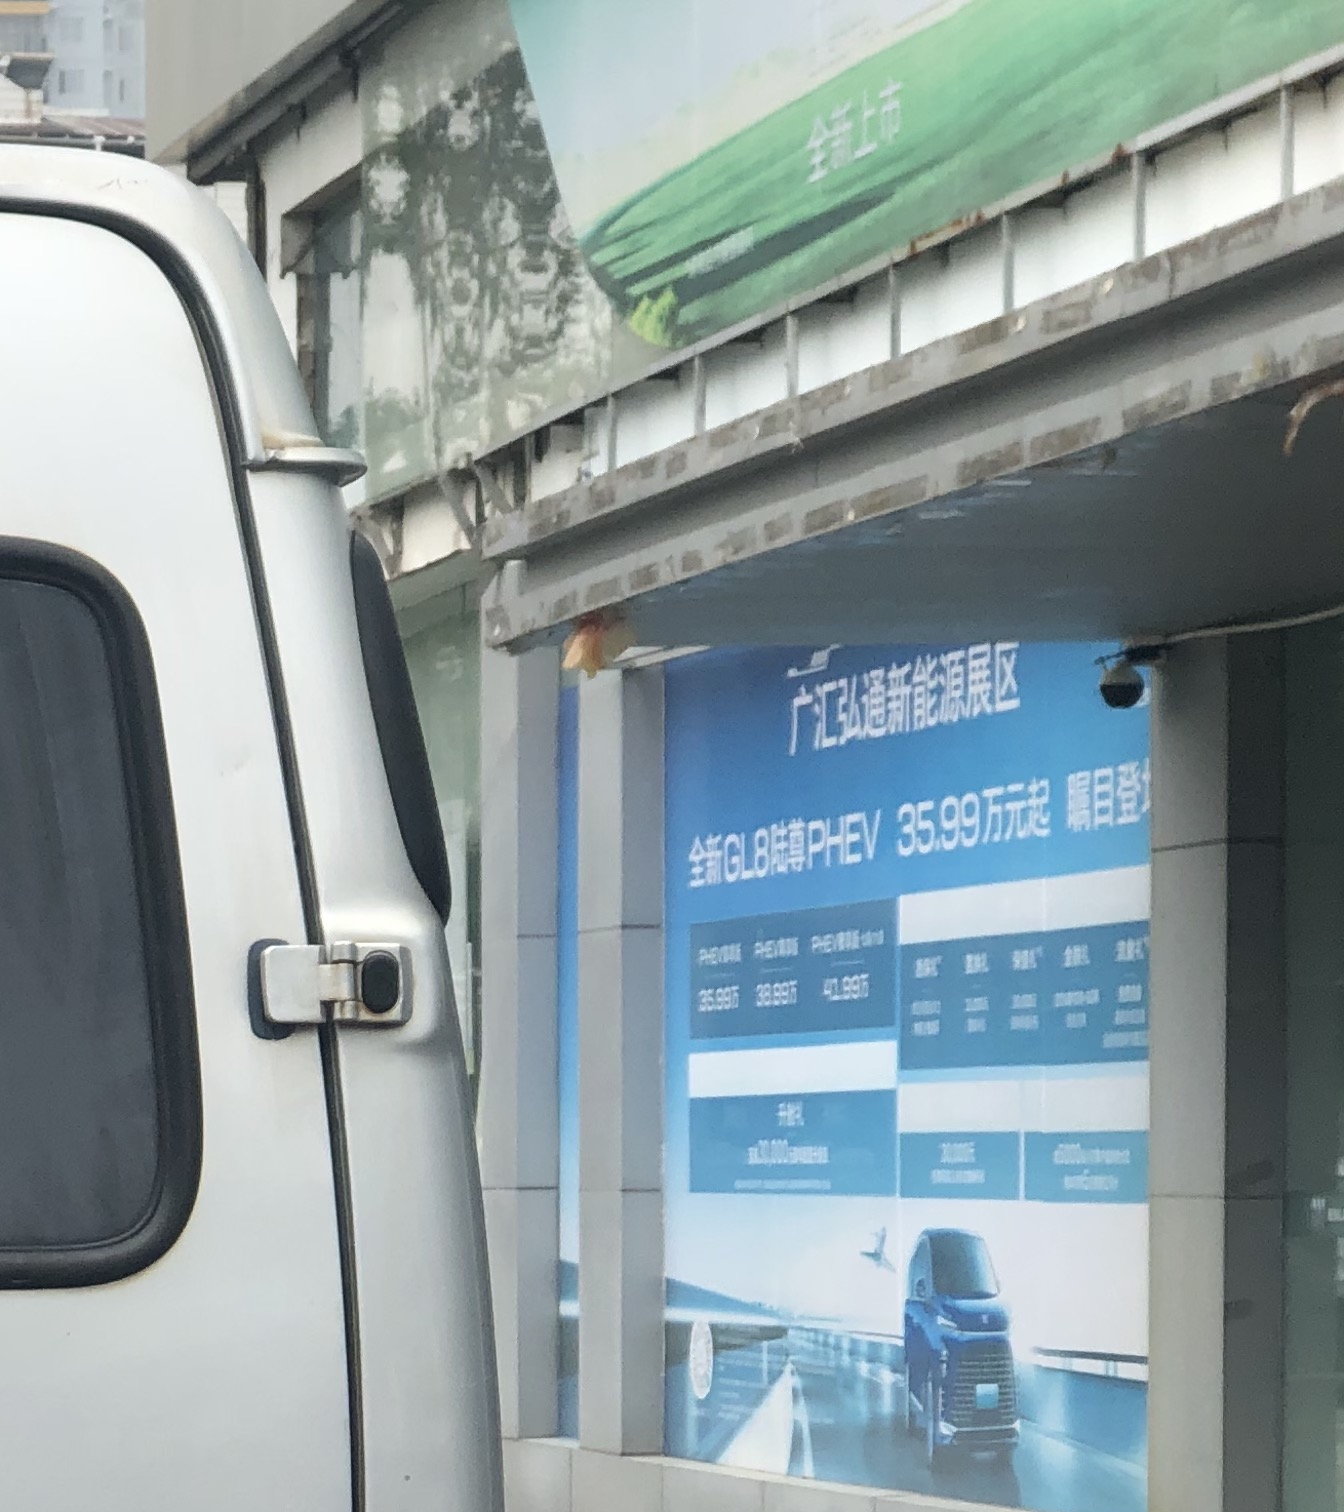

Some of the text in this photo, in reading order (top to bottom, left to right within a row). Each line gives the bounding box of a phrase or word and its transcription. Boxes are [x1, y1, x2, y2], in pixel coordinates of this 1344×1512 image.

[789, 642, 1021, 757] 广汇弘通新能源展区
[897, 776, 1052, 858] 35.99万元起
[1067, 757, 1151, 832] 瞩目登
